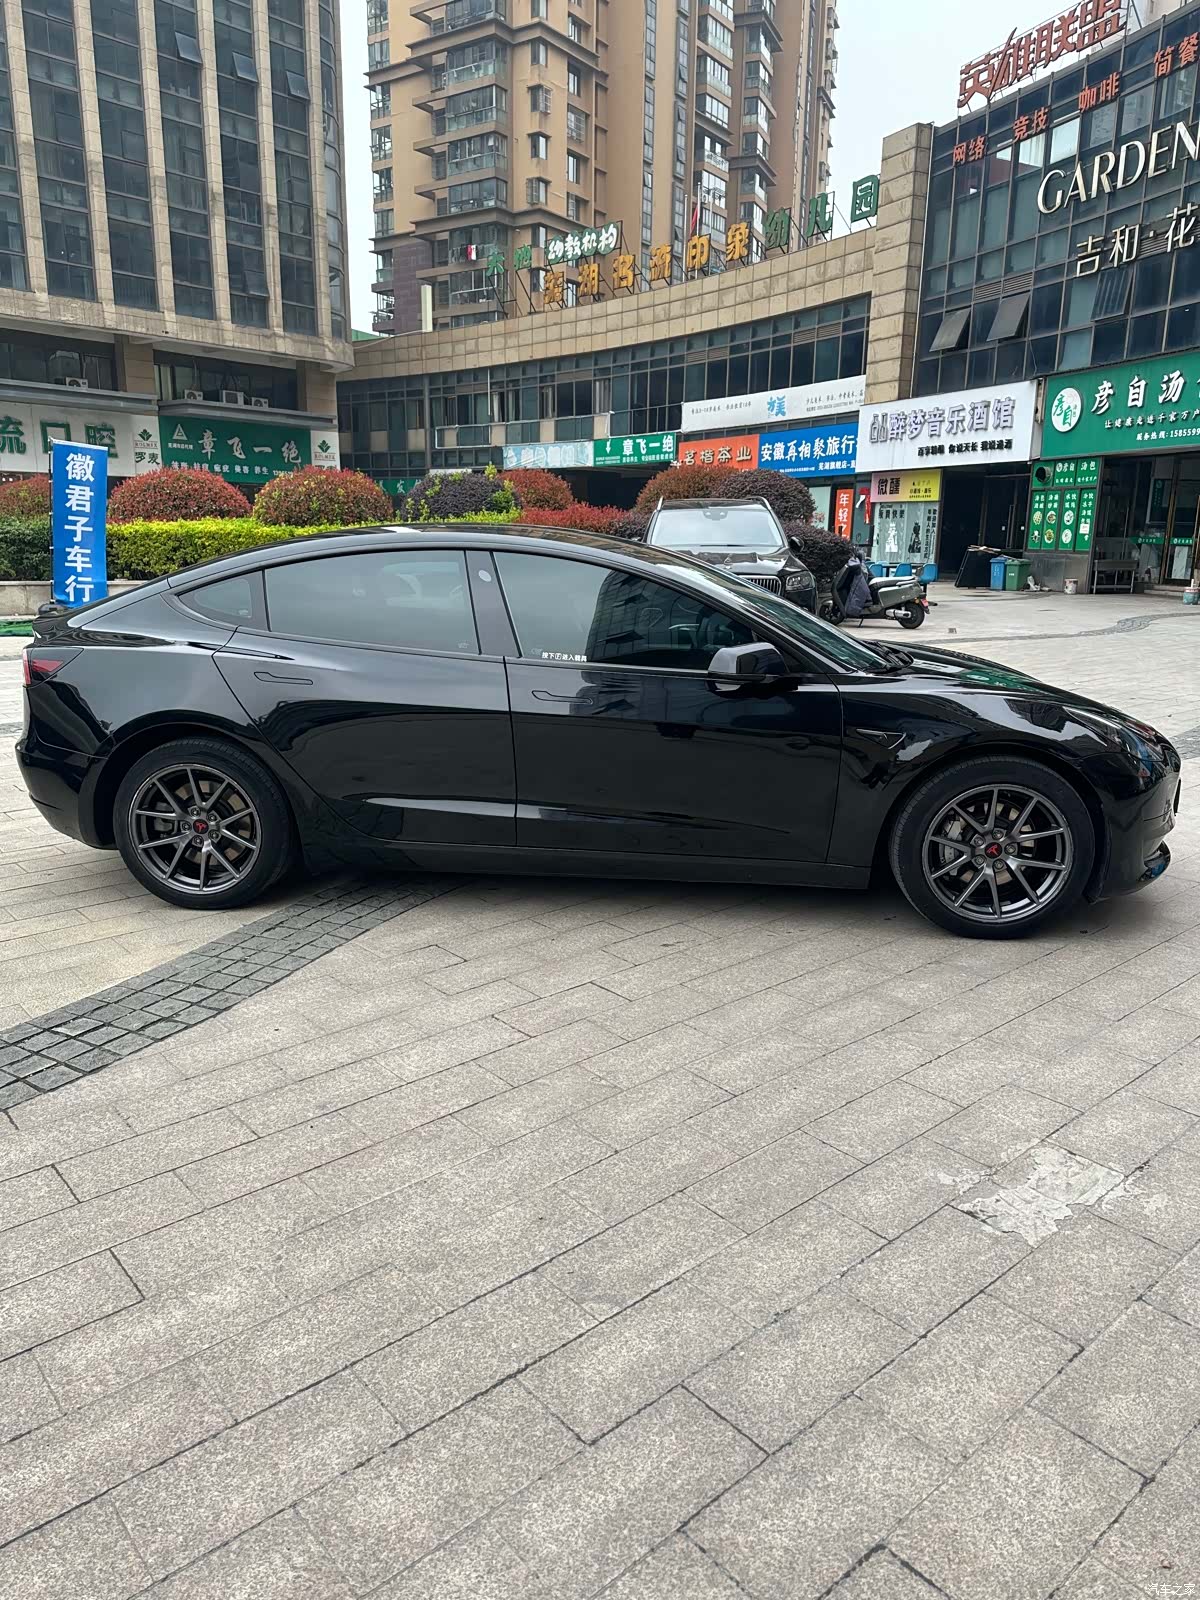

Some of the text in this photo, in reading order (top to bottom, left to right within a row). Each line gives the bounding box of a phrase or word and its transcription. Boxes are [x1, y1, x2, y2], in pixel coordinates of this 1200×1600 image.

[957, 0, 1127, 108] 英雄联盟
[953, 32, 1200, 165] 网络 竞技 咖啡 简餐
[1037, 121, 1200, 214] GARDEN
[547, 222, 618, 263] 幼教机构
[1091, 370, 1200, 415] 彦自汤
[888, 396, 1017, 441] 醉梦音乐酒馆
[198, 428, 303, 464] 章飞一绝
[622, 434, 674, 456] 章飞一绝
[684, 445, 753, 466] 茗楷茶业
[760, 434, 859, 463] 安徽再相聚旅行
[64, 452, 95, 603] 徽君子车行
